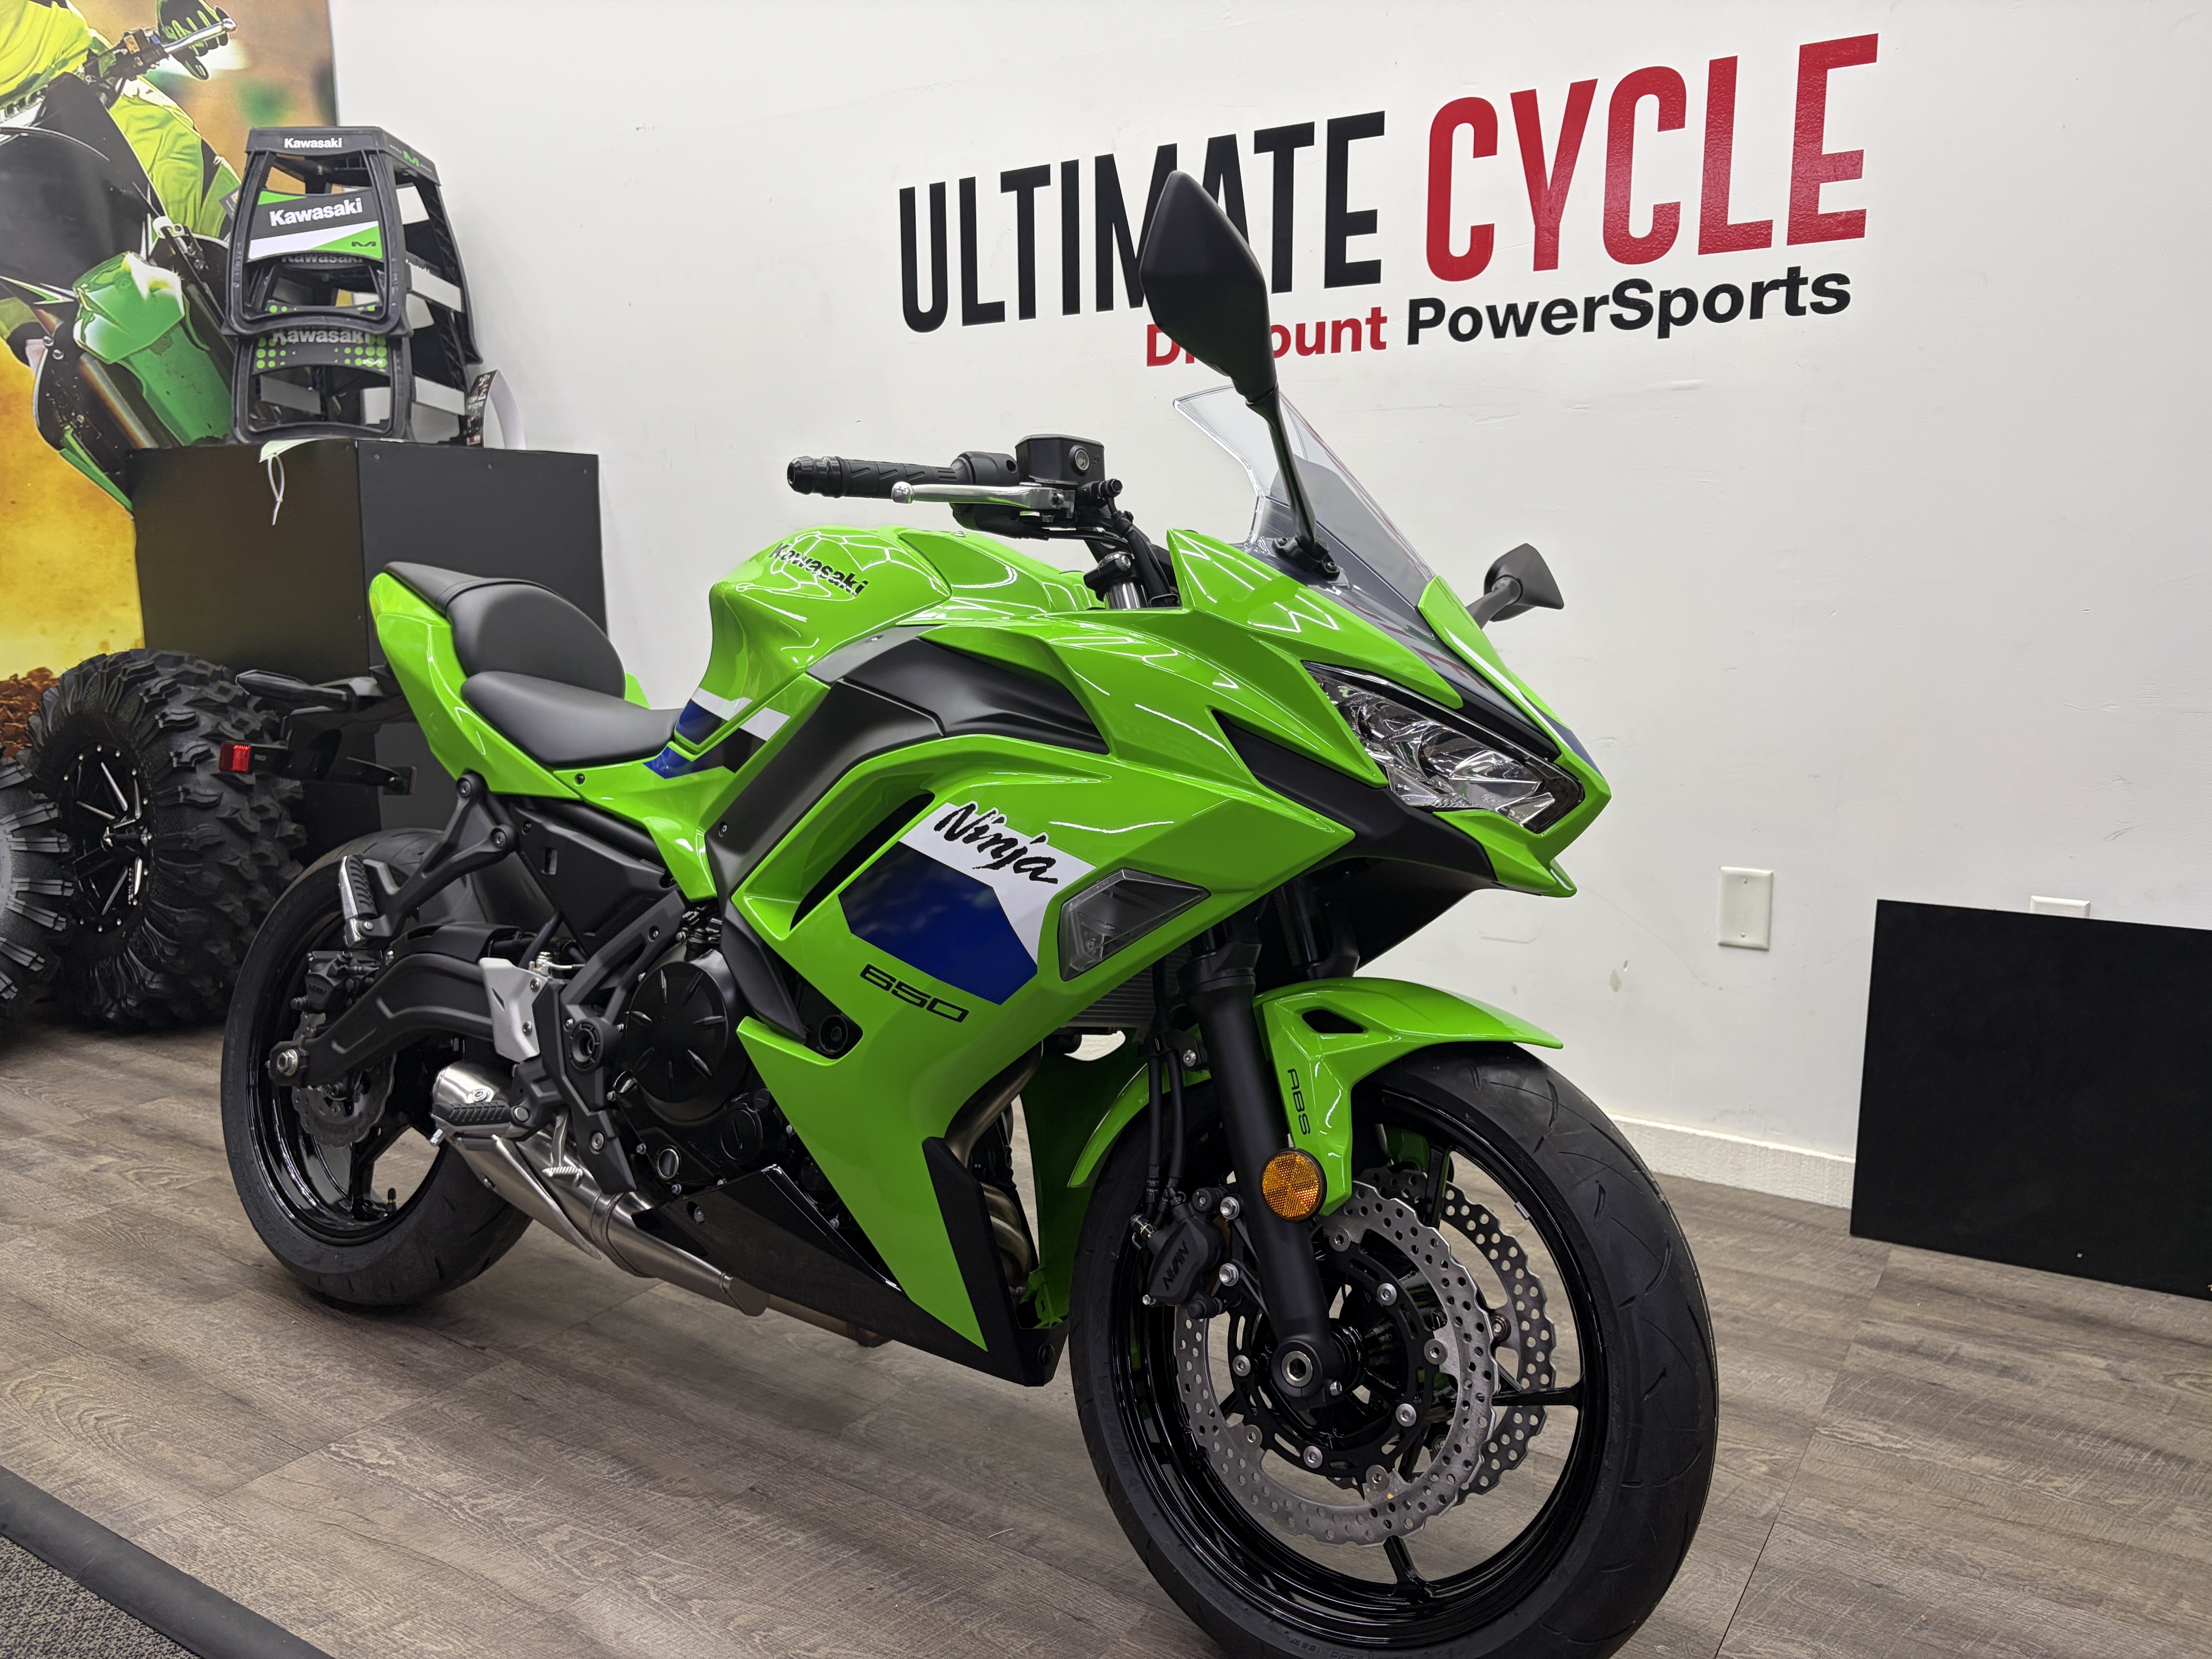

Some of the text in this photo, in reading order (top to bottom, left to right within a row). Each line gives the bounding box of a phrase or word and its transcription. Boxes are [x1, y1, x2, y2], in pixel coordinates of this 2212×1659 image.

[284, 137, 342, 148] Kawasaki
[1427, 34, 1878, 282] CYCLE
[270, 198, 363, 227] Kawasaki
[1147, 266, 1851, 367] Dount PowerSports
[769, 543, 869, 597] Kawasaki
[934, 803, 1058, 884] Ninja
[860, 963, 970, 1023] 650
[1287, 1068, 1311, 1135] ABS
